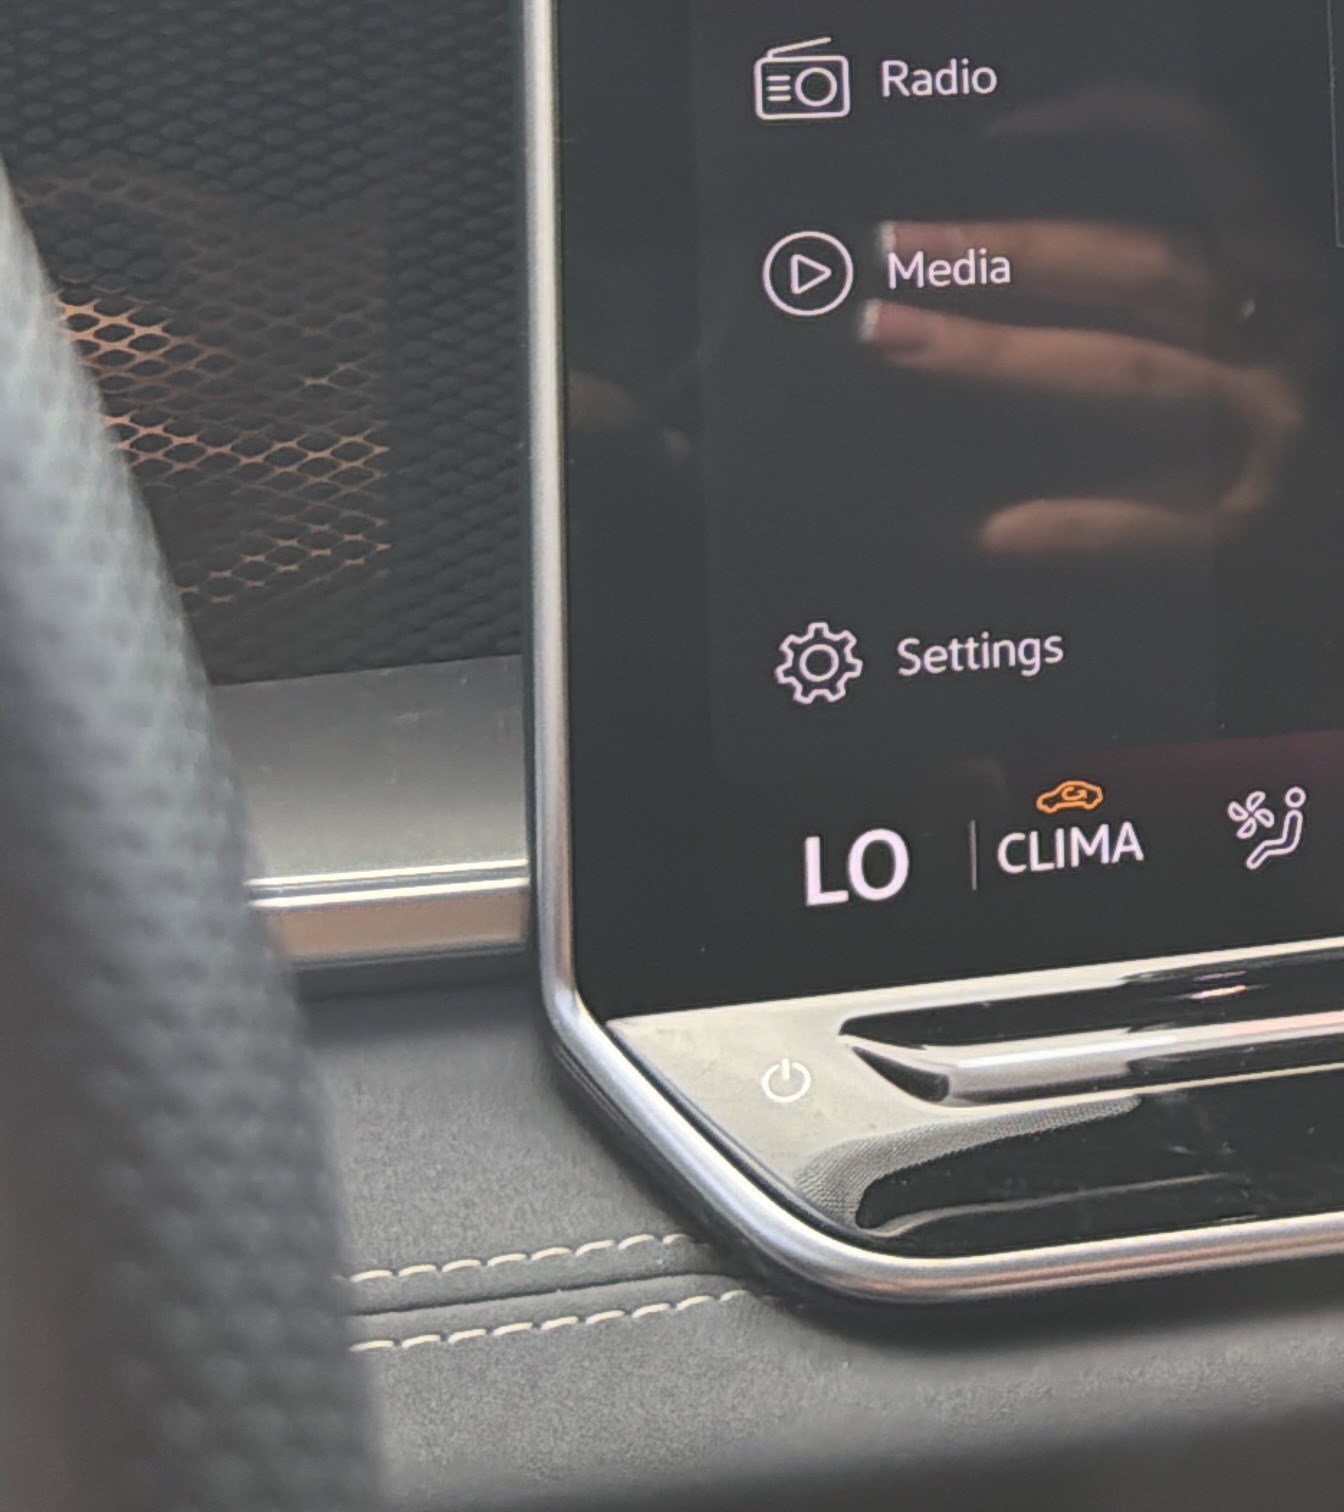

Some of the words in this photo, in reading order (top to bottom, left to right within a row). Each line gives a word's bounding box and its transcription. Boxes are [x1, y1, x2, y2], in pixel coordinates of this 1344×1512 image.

[881, 57, 998, 98] Radio
[888, 249, 1012, 291] Media
[896, 630, 1064, 678] Settings
[804, 828, 910, 907] LO
[997, 821, 1144, 875] CLIMA
